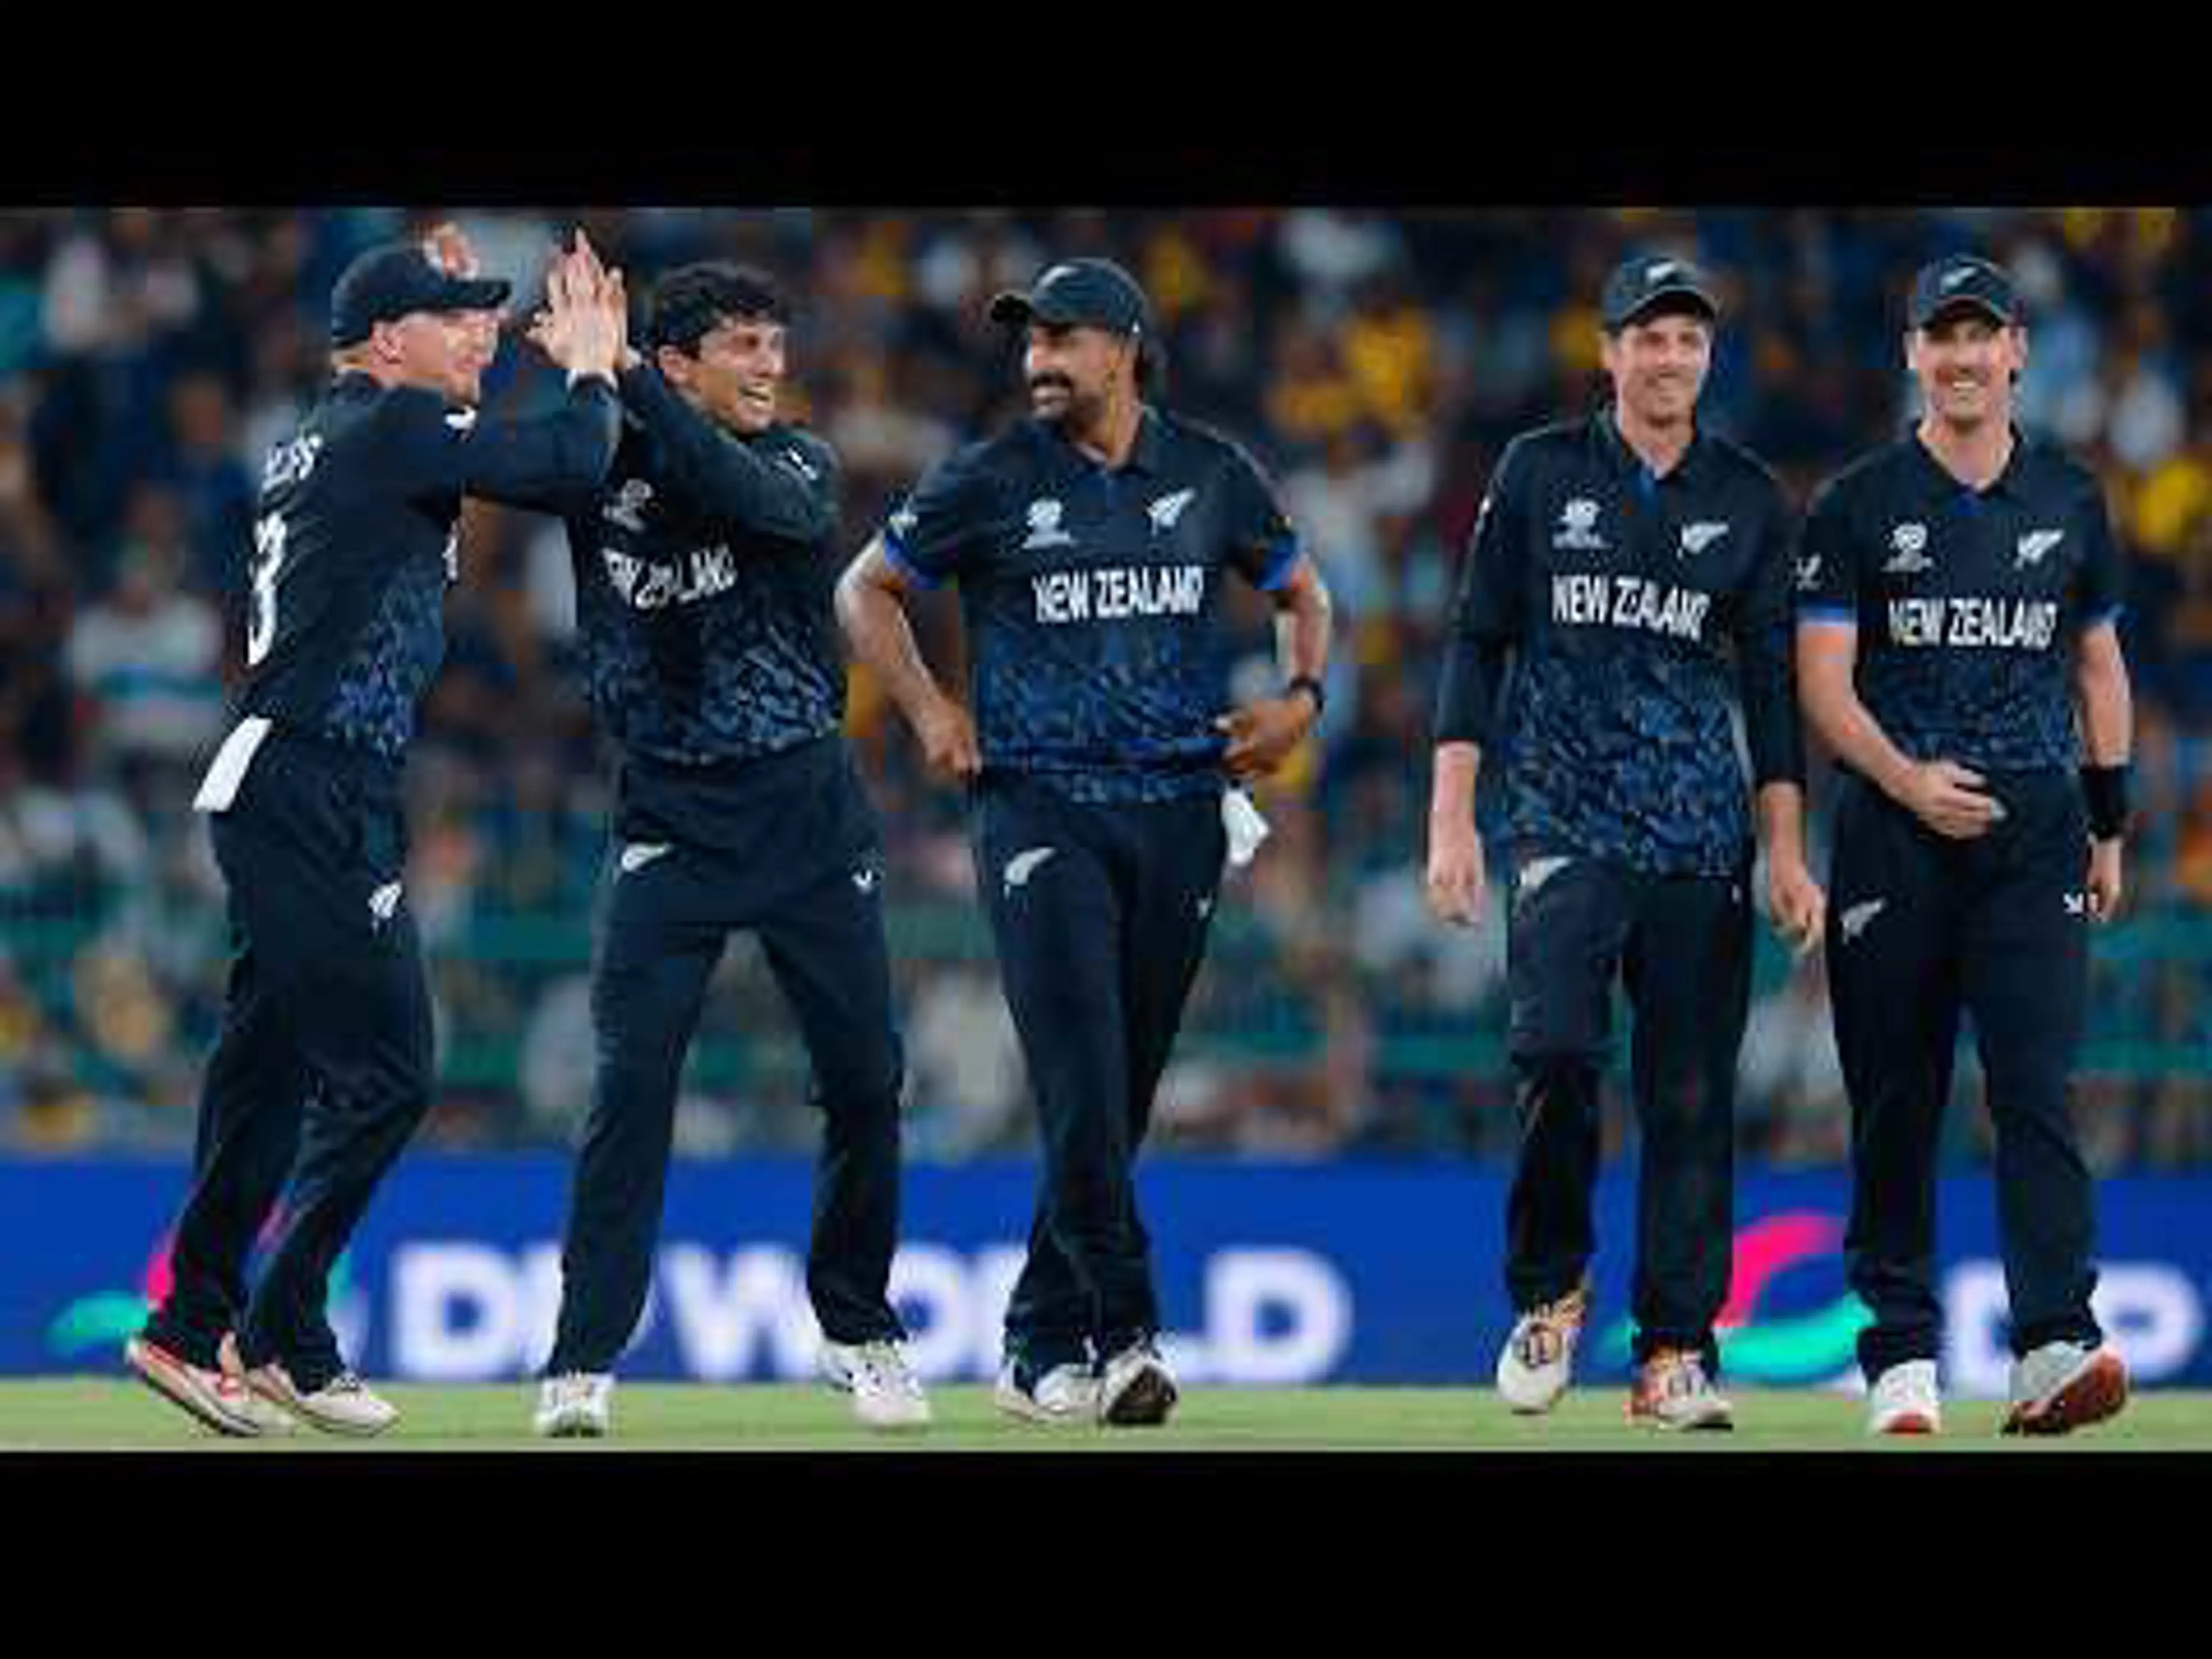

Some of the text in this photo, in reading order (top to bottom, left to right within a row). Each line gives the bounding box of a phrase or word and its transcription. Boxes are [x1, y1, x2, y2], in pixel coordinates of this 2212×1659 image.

[1032, 565, 1204, 623] NEW ZEALAND
[1552, 575, 1610, 624] NEW
[1888, 597, 2058, 650] NEW ZEALAND
